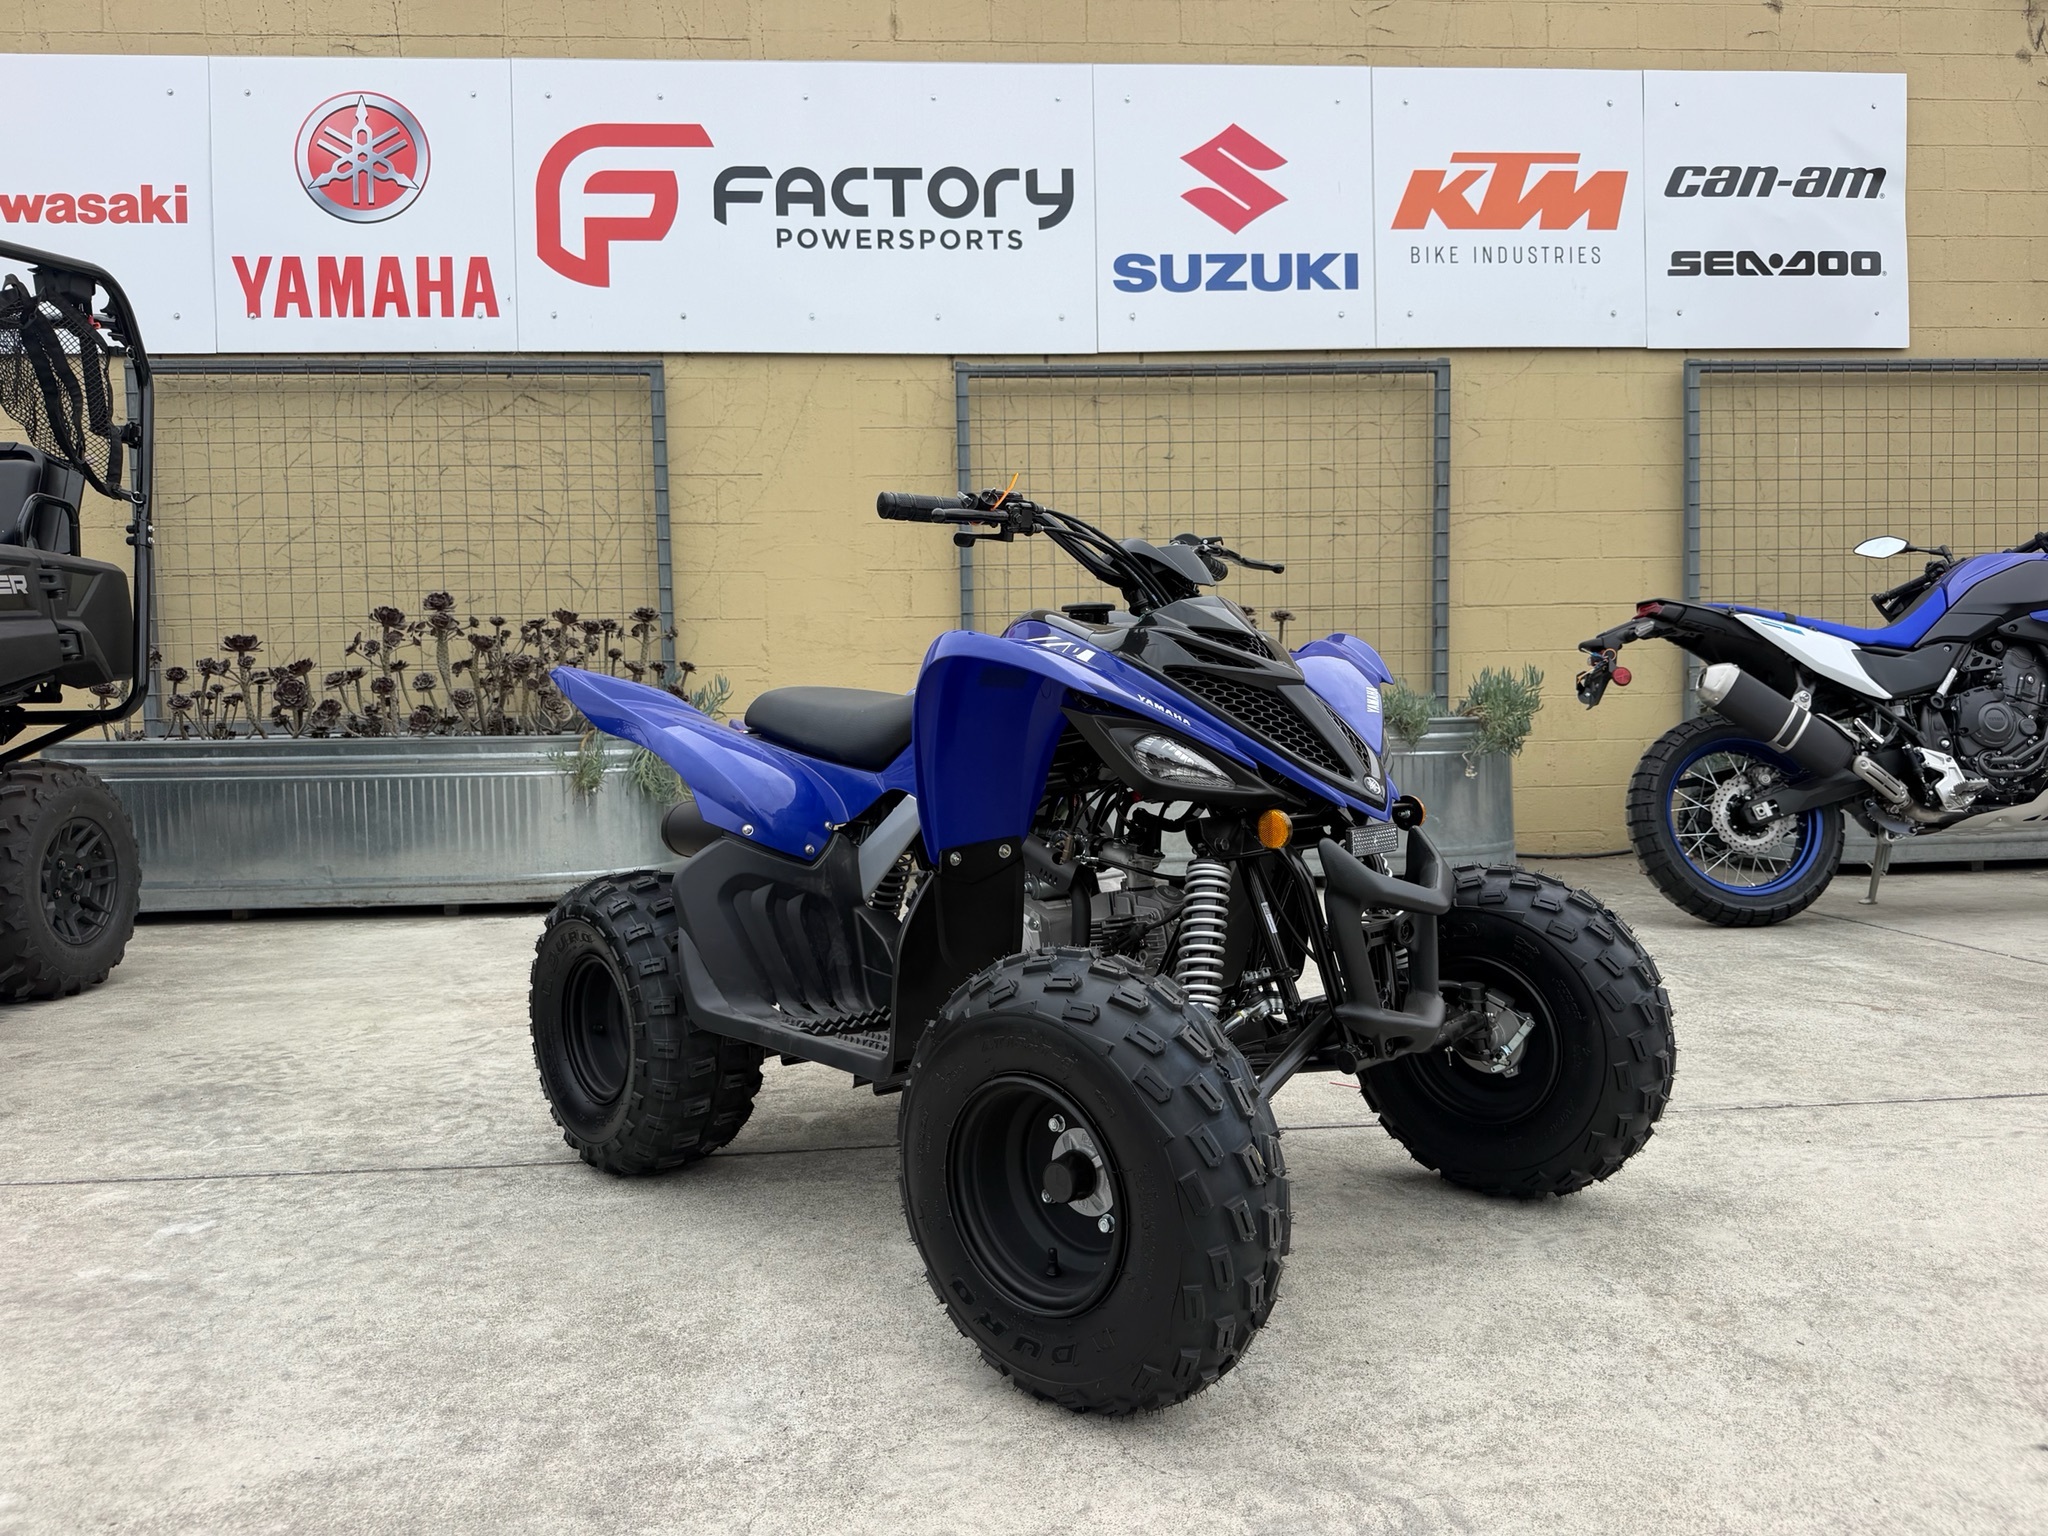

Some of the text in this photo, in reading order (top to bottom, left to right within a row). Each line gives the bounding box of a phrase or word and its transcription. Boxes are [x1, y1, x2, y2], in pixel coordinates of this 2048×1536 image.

[0, 185, 188, 224] wasaki
[713, 165, 1074, 230] FACTORY
[1391, 152, 1628, 230] KTM
[776, 228, 1023, 250] POWERSPORTS
[1410, 246, 1602, 264] BIKE INDUSTRIES
[232, 255, 500, 318] YAMAHA
[1113, 253, 1359, 293] SUZUKI
[1137, 693, 1191, 727] YAMAHA
